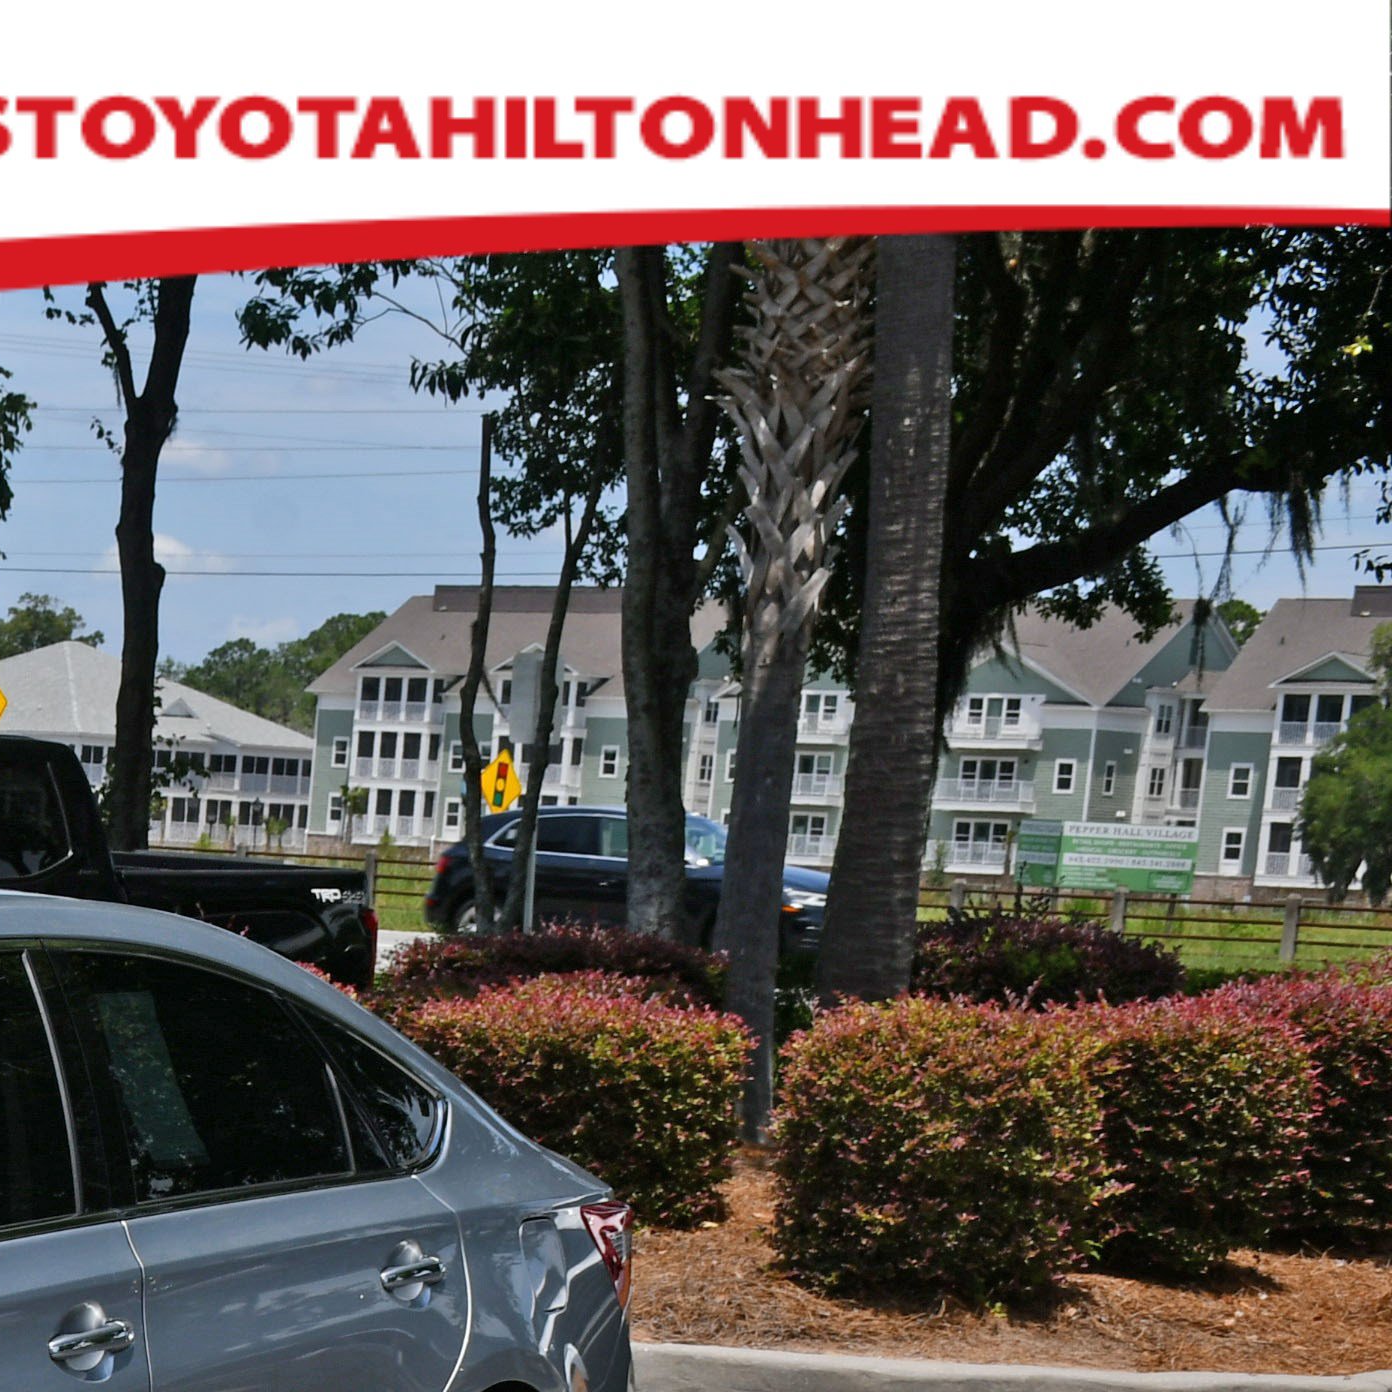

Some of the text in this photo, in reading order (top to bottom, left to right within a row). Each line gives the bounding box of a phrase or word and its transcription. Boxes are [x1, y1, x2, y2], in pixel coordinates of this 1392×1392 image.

[1068, 824, 1110, 835] PEPPER
[1112, 827, 1142, 837] HALL
[1146, 829, 1194, 840] VILLAGE
